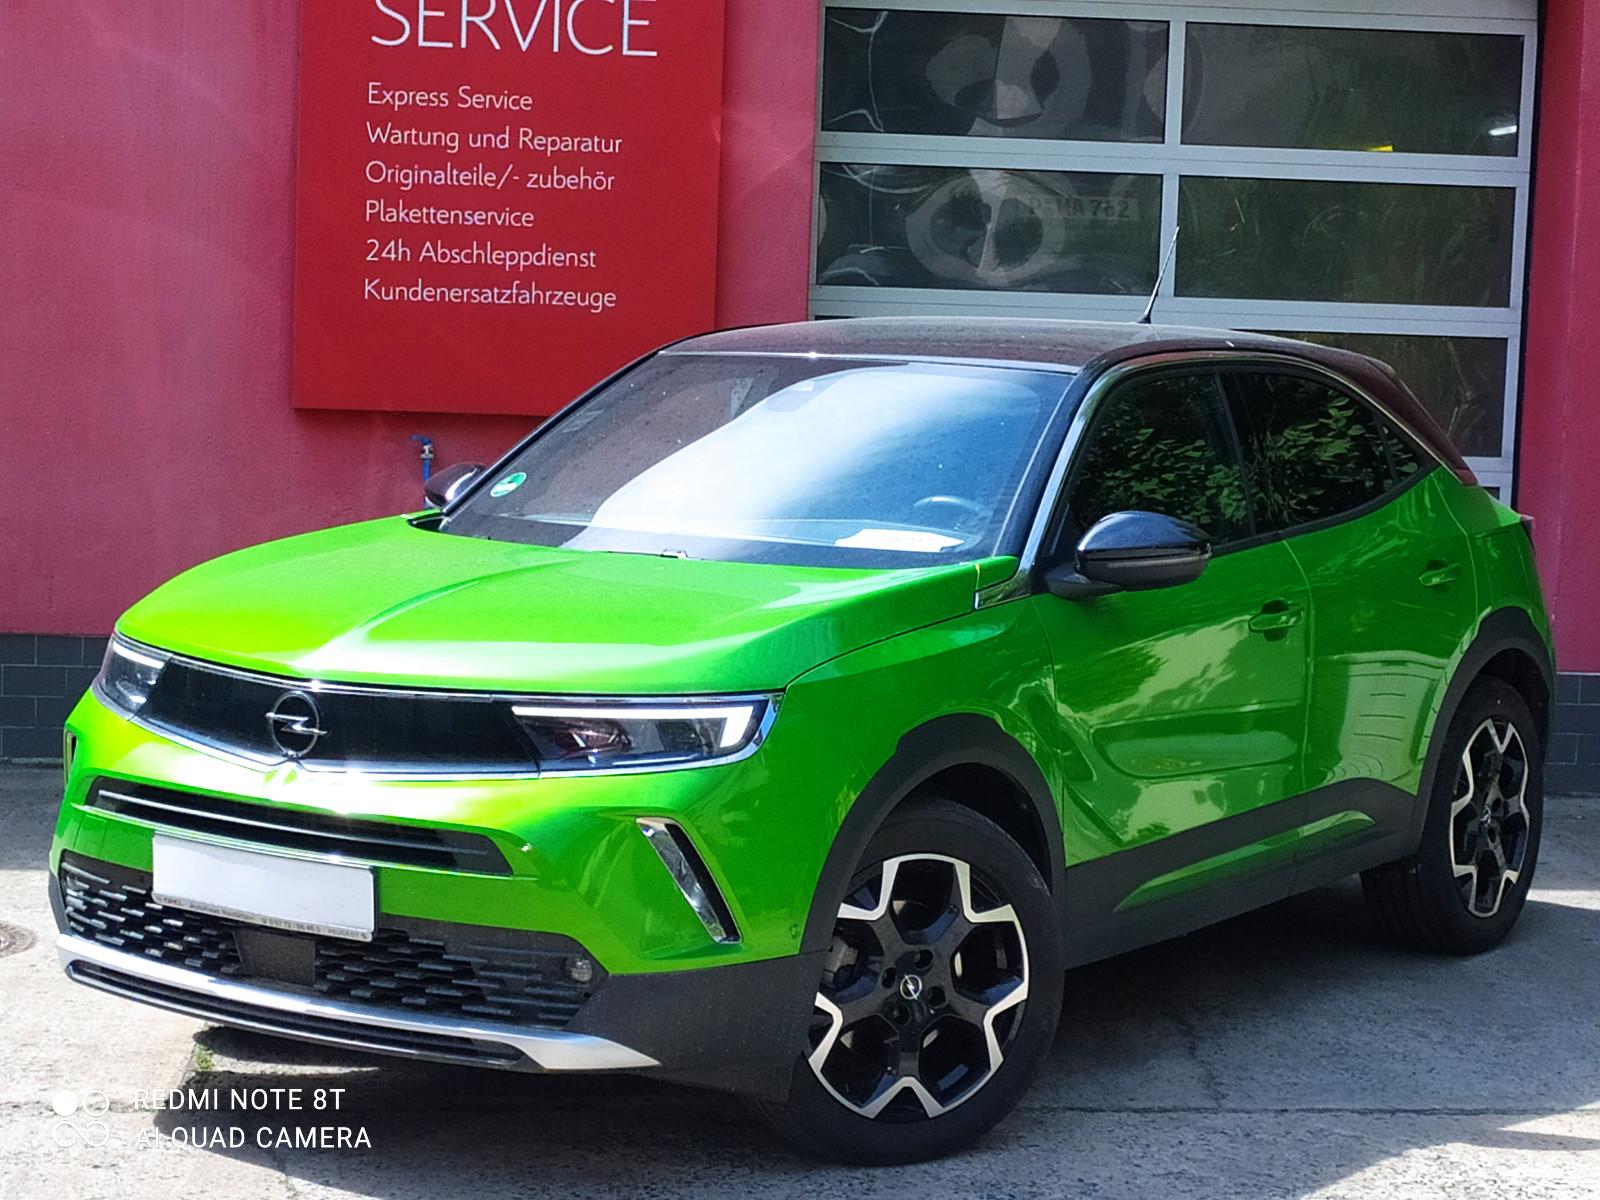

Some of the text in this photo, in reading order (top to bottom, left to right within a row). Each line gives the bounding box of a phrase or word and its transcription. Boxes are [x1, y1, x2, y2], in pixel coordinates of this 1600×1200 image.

[371, 0, 658, 56] SERVICE
[368, 81, 533, 111] Express Service
[366, 121, 623, 157] Wartung und Reparatur
[526, 166, 615, 191] zubehör
[365, 199, 535, 227] Plakettenservice
[366, 239, 597, 271] 24h Abschleppdienst
[364, 278, 617, 312] Kundenersatzfahrzeuge
